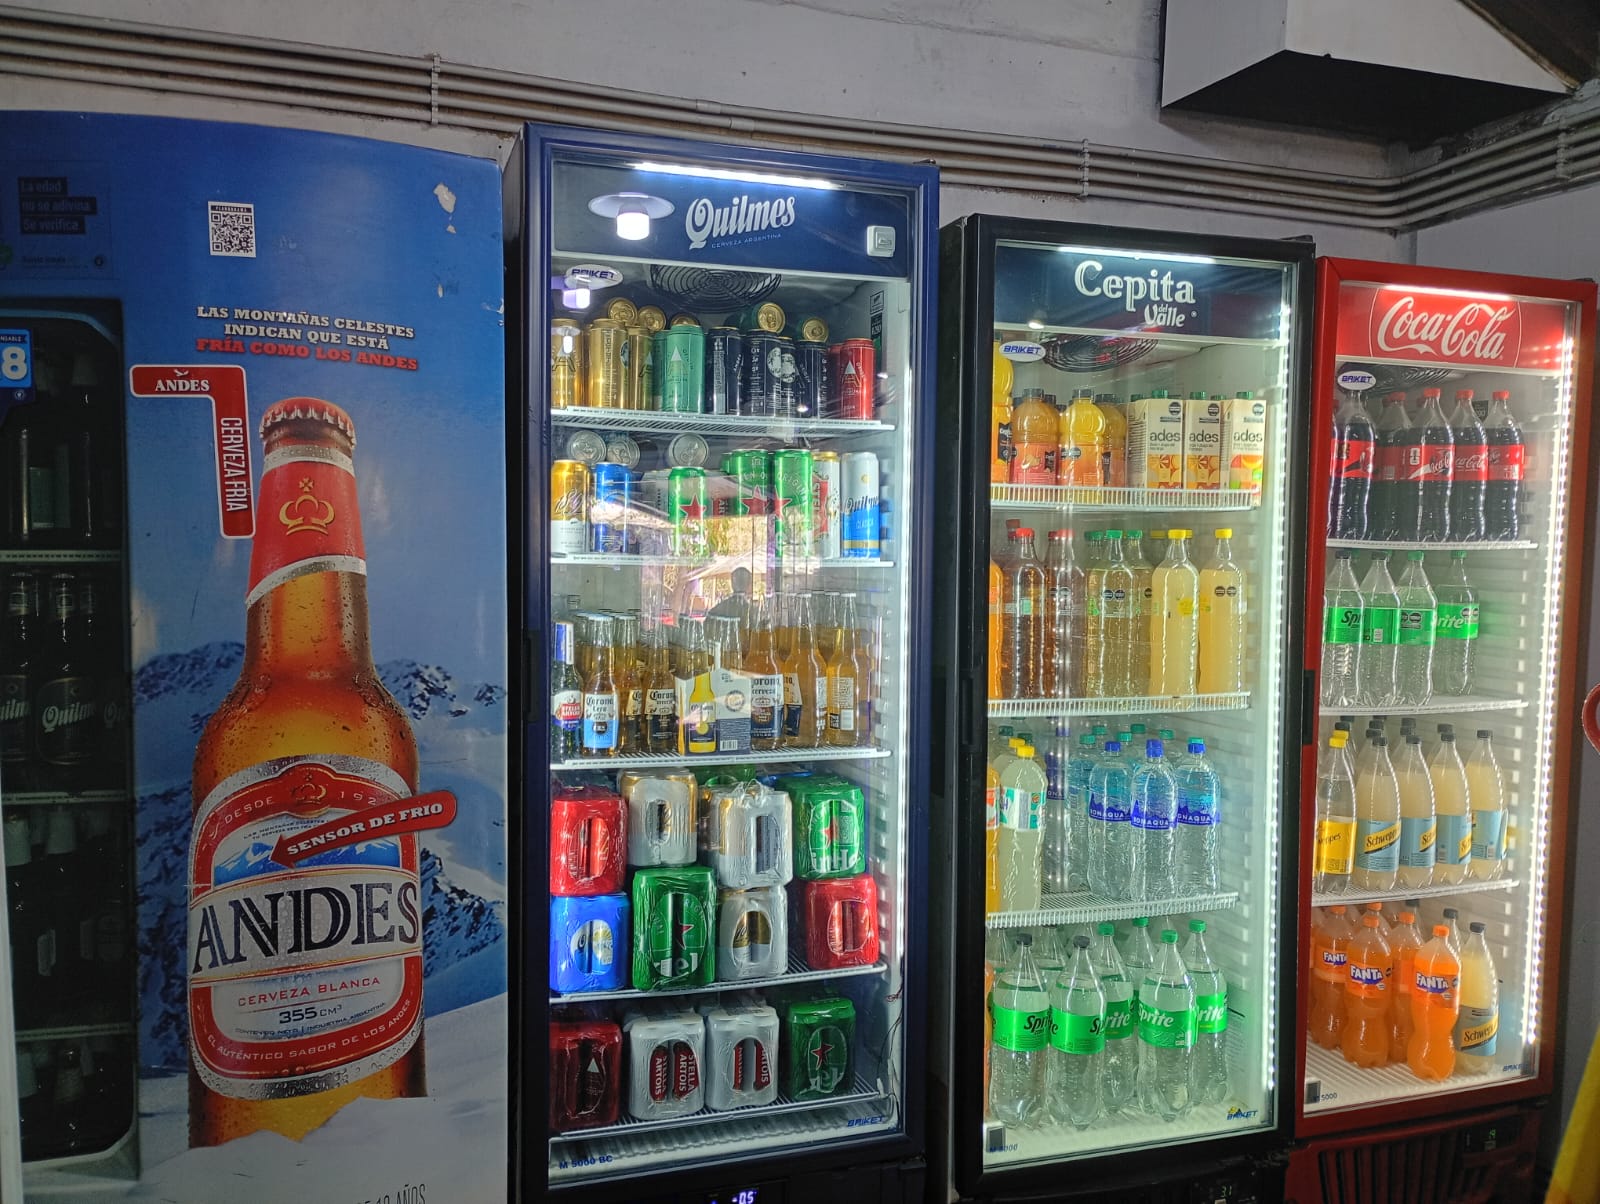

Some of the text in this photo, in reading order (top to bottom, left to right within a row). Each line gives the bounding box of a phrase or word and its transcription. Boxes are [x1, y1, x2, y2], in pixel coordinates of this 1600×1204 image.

[685, 195, 795, 250] Quilmes
[1075, 260, 1196, 312] Cepita
[197, 306, 415, 339] LAS MONTAÑAS CELESTES
[1144, 304, 1185, 327] Valle
[1158, 303, 1168, 313] del
[224, 323, 390, 350] INDICAN QUE ESTÁ
[1377, 296, 1516, 360] Coca-Cola
[196, 336, 418, 371] FRÍA COMO LOS ANDES
[155, 379, 210, 392] ANDES
[1149, 428, 1181, 441] ades
[1189, 429, 1219, 443] ades
[1233, 428, 1263, 442] ades
[220, 417, 249, 512] CERVEZA FRIA
[224, 790, 378, 825] DESDE 192
[1177, 813, 1211, 822] ONAQUA
[287, 803, 444, 856] SENSOR DE FRIO
[192, 881, 420, 975] ANDES
[1350, 964, 1383, 981] FANTA
[1416, 972, 1449, 990] FANTA
[238, 976, 381, 1007] CERVEZA BLANCA
[207, 998, 411, 1060] EL AUTÉNTICO SABOR DE LOS ANDES
[279, 1007, 318, 1024] 355
[655, 1057, 663, 1096] ARTOIS
[679, 1054, 687, 1092] ARTOIS
[687, 1054, 696, 1092] STELLA
[559, 1161, 568, 1170] M
[599, 1154, 613, 1164] BC
